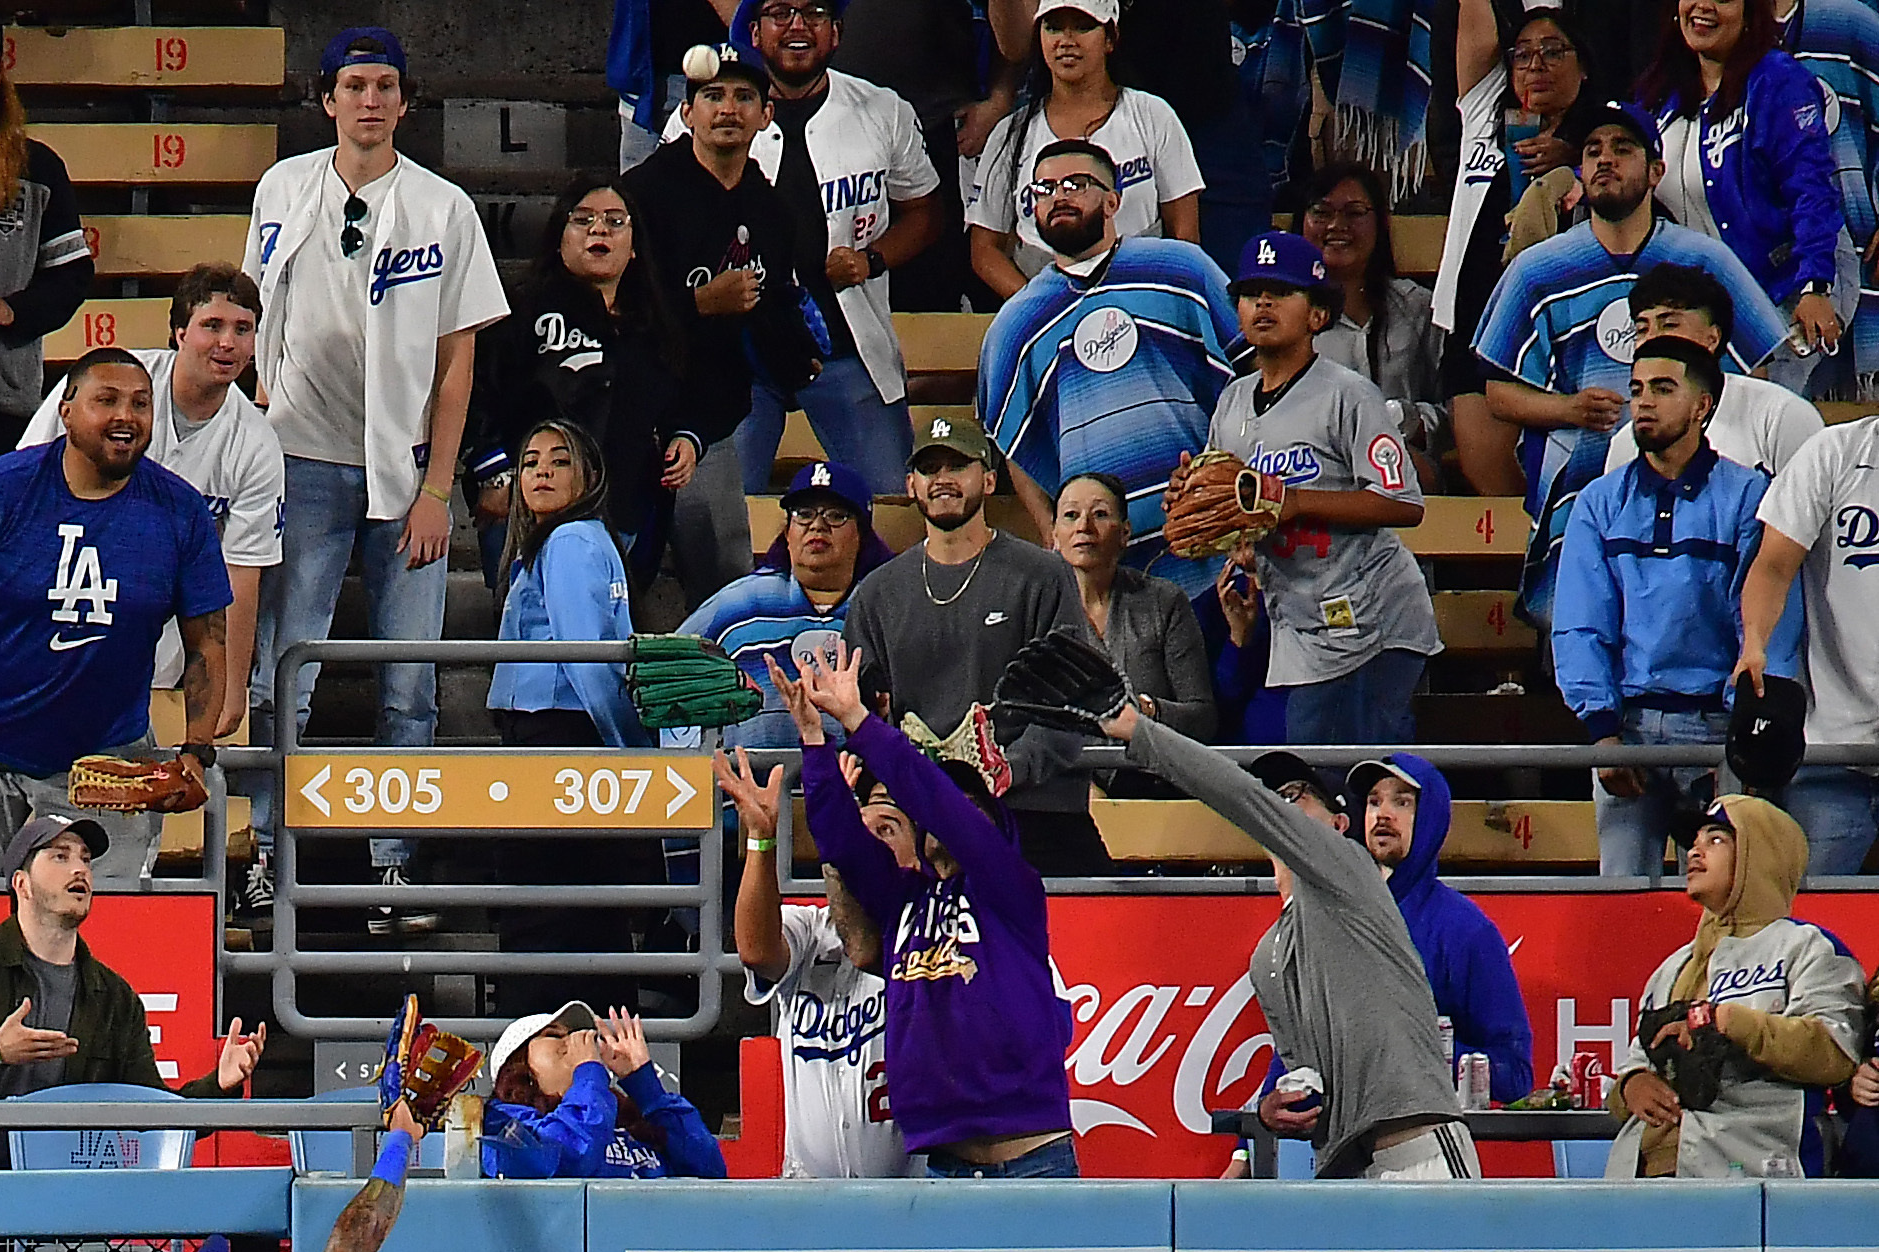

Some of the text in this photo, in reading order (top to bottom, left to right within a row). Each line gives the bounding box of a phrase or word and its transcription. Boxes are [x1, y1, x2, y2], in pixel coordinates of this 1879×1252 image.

[156, 38, 188, 71] 19
[720, 42, 739, 62] LA
[501, 107, 527, 153] L
[153, 134, 186, 168] 19
[1258, 239, 1276, 265] LA
[370, 243, 443, 305] gers
[84, 313, 116, 348] 18
[931, 418, 950, 438] LA
[810, 463, 830, 486] LA
[1476, 510, 1494, 544] 4
[48, 523, 118, 625] LA
[1488, 601, 1506, 635] 4
[344, 768, 652, 815] 305 307
[1514, 815, 1532, 850] 4
[1708, 959, 1786, 1003] gers
